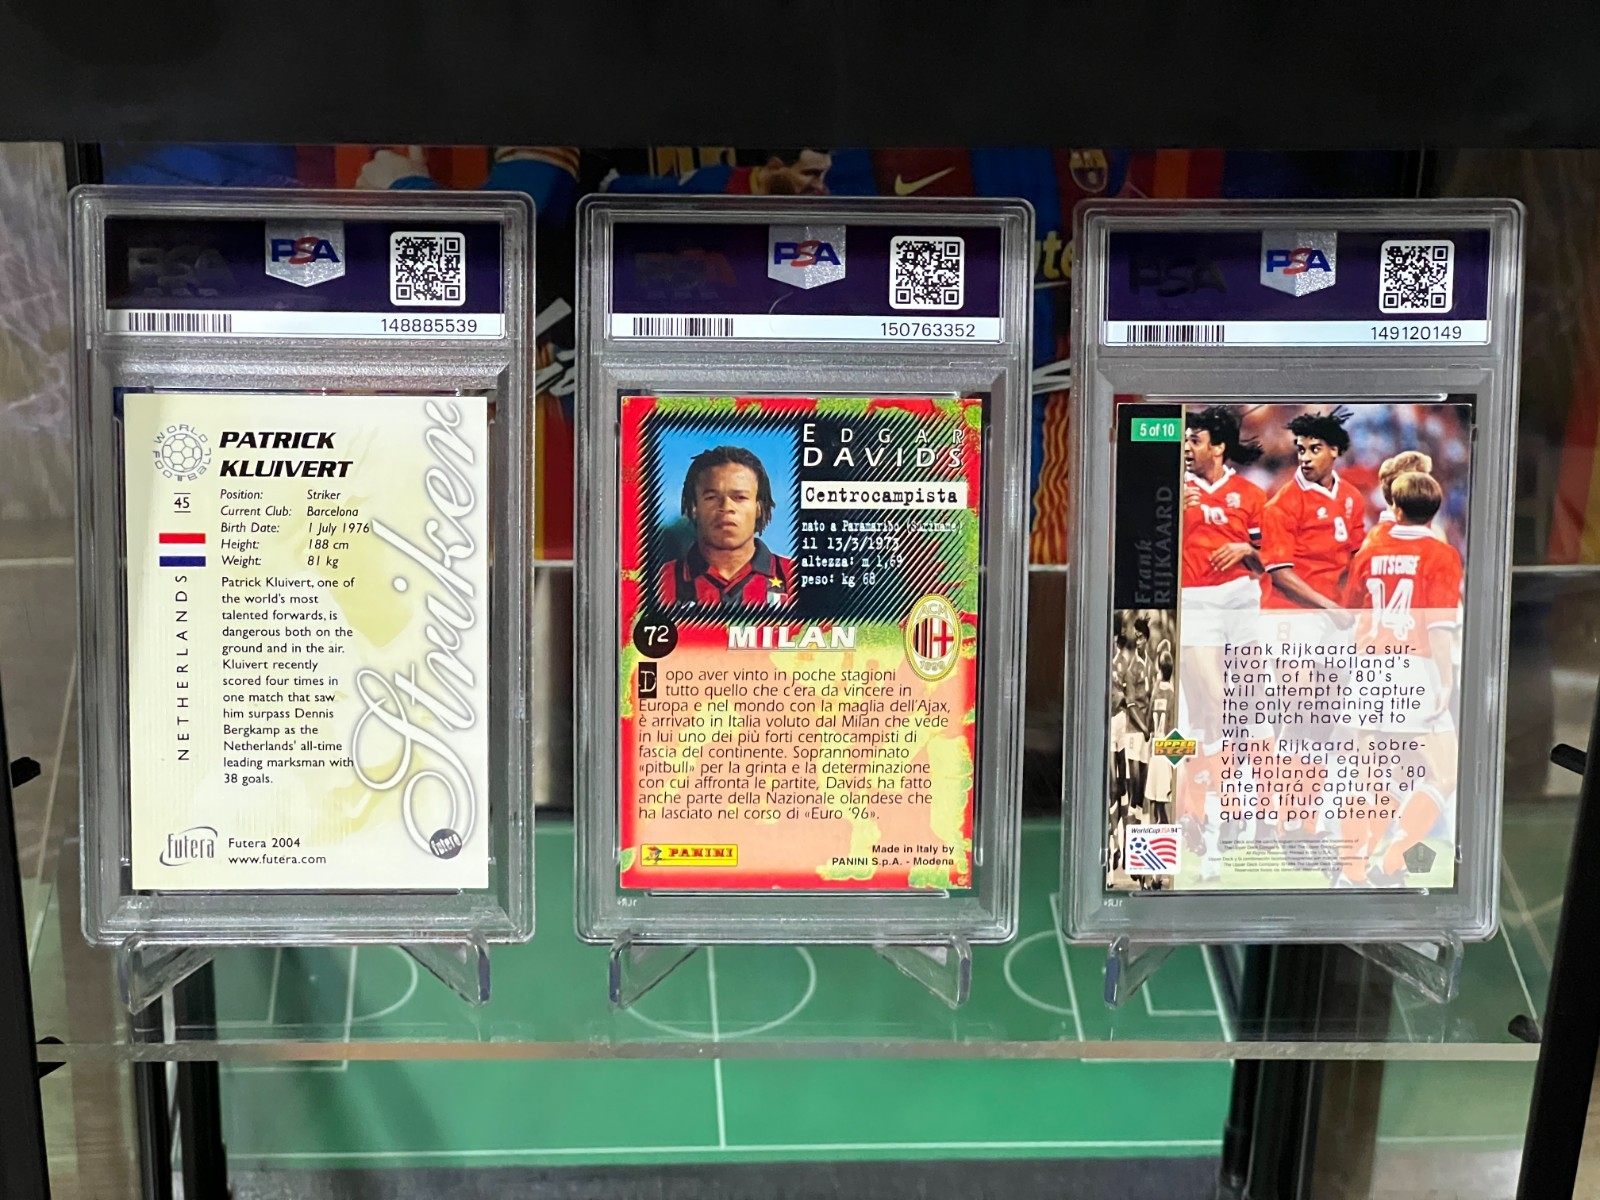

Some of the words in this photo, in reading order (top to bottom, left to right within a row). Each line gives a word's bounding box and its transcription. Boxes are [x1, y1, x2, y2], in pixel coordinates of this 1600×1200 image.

[271, 236, 341, 264] PSA
[774, 240, 841, 268] PSA
[1266, 247, 1332, 275] PSA
[380, 319, 478, 333] 148885539
[881, 322, 976, 338] 150763352
[1371, 326, 1462, 341] 149120149
[154, 424, 208, 444] WORLD
[803, 424, 964, 444] EDGAR
[1140, 424, 1147, 437] 5
[1149, 423, 1160, 437] of
[1163, 424, 1175, 437] 10
[219, 431, 336, 449] PATRICK
[152, 448, 211, 481] FOOTBALL
[803, 447, 963, 468] DAVIDS
[219, 460, 354, 478] KLUIVERT
[220, 489, 264, 500] Position:
[307, 489, 342, 500] Striker
[805, 486, 958, 506] Centrocampista
[174, 496, 190, 509] 45
[221, 506, 261, 516] Current
[265, 506, 292, 516] Club:
[307, 506, 359, 516] Barcelona
[221, 522, 247, 533] Birth
[251, 522, 280, 533] Date:
[309, 522, 313, 533] 1
[319, 522, 338, 536] July
[343, 522, 370, 533] 1976
[801, 521, 826, 532] nato
[830, 523, 838, 532] a
[221, 539, 260, 553] Height:
[309, 539, 330, 550] 188
[333, 542, 349, 550] cm
[801, 537, 818, 549] il
[828, 536, 901, 552] 13/3/1973
[1154, 486, 1174, 604] RIJKAARD
[222, 556, 262, 570] Weight:
[308, 556, 321, 566] 81
[326, 556, 339, 570] kg
[801, 556, 854, 568] altezza:
[861, 558, 871, 567] m
[222, 577, 262, 587] Patrick
[266, 577, 315, 590] Kluivert,
[343, 577, 356, 587] of
[801, 574, 834, 587] peso:
[842, 574, 856, 587] kg
[863, 573, 876, 586] 68
[222, 594, 241, 604] the
[245, 594, 286, 604] world's
[290, 594, 319, 604] most
[222, 610, 269, 620] talented
[273, 610, 327, 623] forwards,
[330, 610, 338, 620] is
[222, 627, 281, 640] dangerous
[285, 627, 312, 637] both
[335, 627, 354, 637] the
[644, 625, 669, 644] 72
[728, 626, 857, 649] MILAN
[223, 643, 263, 656] ground
[267, 643, 288, 653] and
[292, 643, 302, 653] in
[306, 643, 325, 653] the
[329, 643, 345, 653] air.
[1225, 643, 1273, 655] Frank
[1282, 643, 1357, 659] Rijkaard
[1366, 646, 1376, 655] a
[1385, 646, 1417, 655] sur-
[176, 575, 190, 761] NETHERLANDS
[223, 659, 269, 669] Kluivert
[273, 659, 319, 672] recently
[1224, 657, 1268, 669] vivor
[1276, 657, 1316, 669] from
[1325, 657, 1410, 669] Holland's
[223, 676, 262, 686] scored
[266, 676, 290, 686] four
[294, 676, 325, 686] times
[329, 676, 339, 686] in
[1224, 670, 1272, 683] team
[1282, 670, 1300, 683] of
[1309, 670, 1339, 683] the
[1350, 670, 1392, 683] '80's
[249, 692, 284, 702] match
[288, 692, 311, 702] that
[1224, 684, 1255, 697] will
[1265, 684, 1331, 701] attempt
[1337, 684, 1353, 697] to
[1359, 684, 1426, 701] capture
[639, 700, 689, 716] Europa
[694, 703, 703, 712] e
[708, 700, 729, 712] nel
[734, 700, 785, 712] mondo
[790, 703, 816, 712] con
[821, 700, 833, 712] la
[839, 700, 885, 716] maglia
[890, 700, 951, 716] dell'Ajax,
[1223, 698, 1249, 711] the
[1256, 698, 1292, 715] only
[1298, 698, 1384, 715] remaining
[1391, 698, 1421, 711] title
[1223, 712, 1249, 724] the
[1255, 712, 1304, 724] Dutch
[1311, 712, 1352, 724] have
[1359, 712, 1384, 728] yet
[1390, 712, 1406, 724] to
[1222, 726, 1254, 738] win.
[1154, 740, 1196, 748] UPPER
[639, 747, 677, 758] fascia
[682, 747, 704, 758] del
[709, 747, 787, 758] continente.
[793, 747, 910, 762] Soprannominato
[639, 792, 682, 804] anche
[687, 792, 723, 808] parte
[728, 792, 761, 804] della
[766, 792, 835, 804] Nazionale
[840, 792, 903, 804] olandese
[908, 792, 933, 804] che
[639, 808, 656, 819] ha
[662, 808, 713, 819] lasciato
[718, 808, 739, 819] nel
[744, 811, 782, 819] corso
[787, 808, 799, 819] di
[805, 808, 843, 819] «Euro
[849, 808, 880, 819] '96».
[167, 833, 215, 860] futera
[229, 837, 267, 848] Futera
[272, 837, 301, 848] 2004
[872, 844, 900, 853] Made
[904, 844, 913, 853] in
[917, 844, 939, 855] Italy
[942, 844, 955, 855] by
[229, 854, 327, 864] www.futera.com
[668, 847, 734, 858] PANINI
[832, 857, 868, 866] PANINI
[872, 857, 903, 868] S.p.A.
[914, 857, 955, 866] Modena
